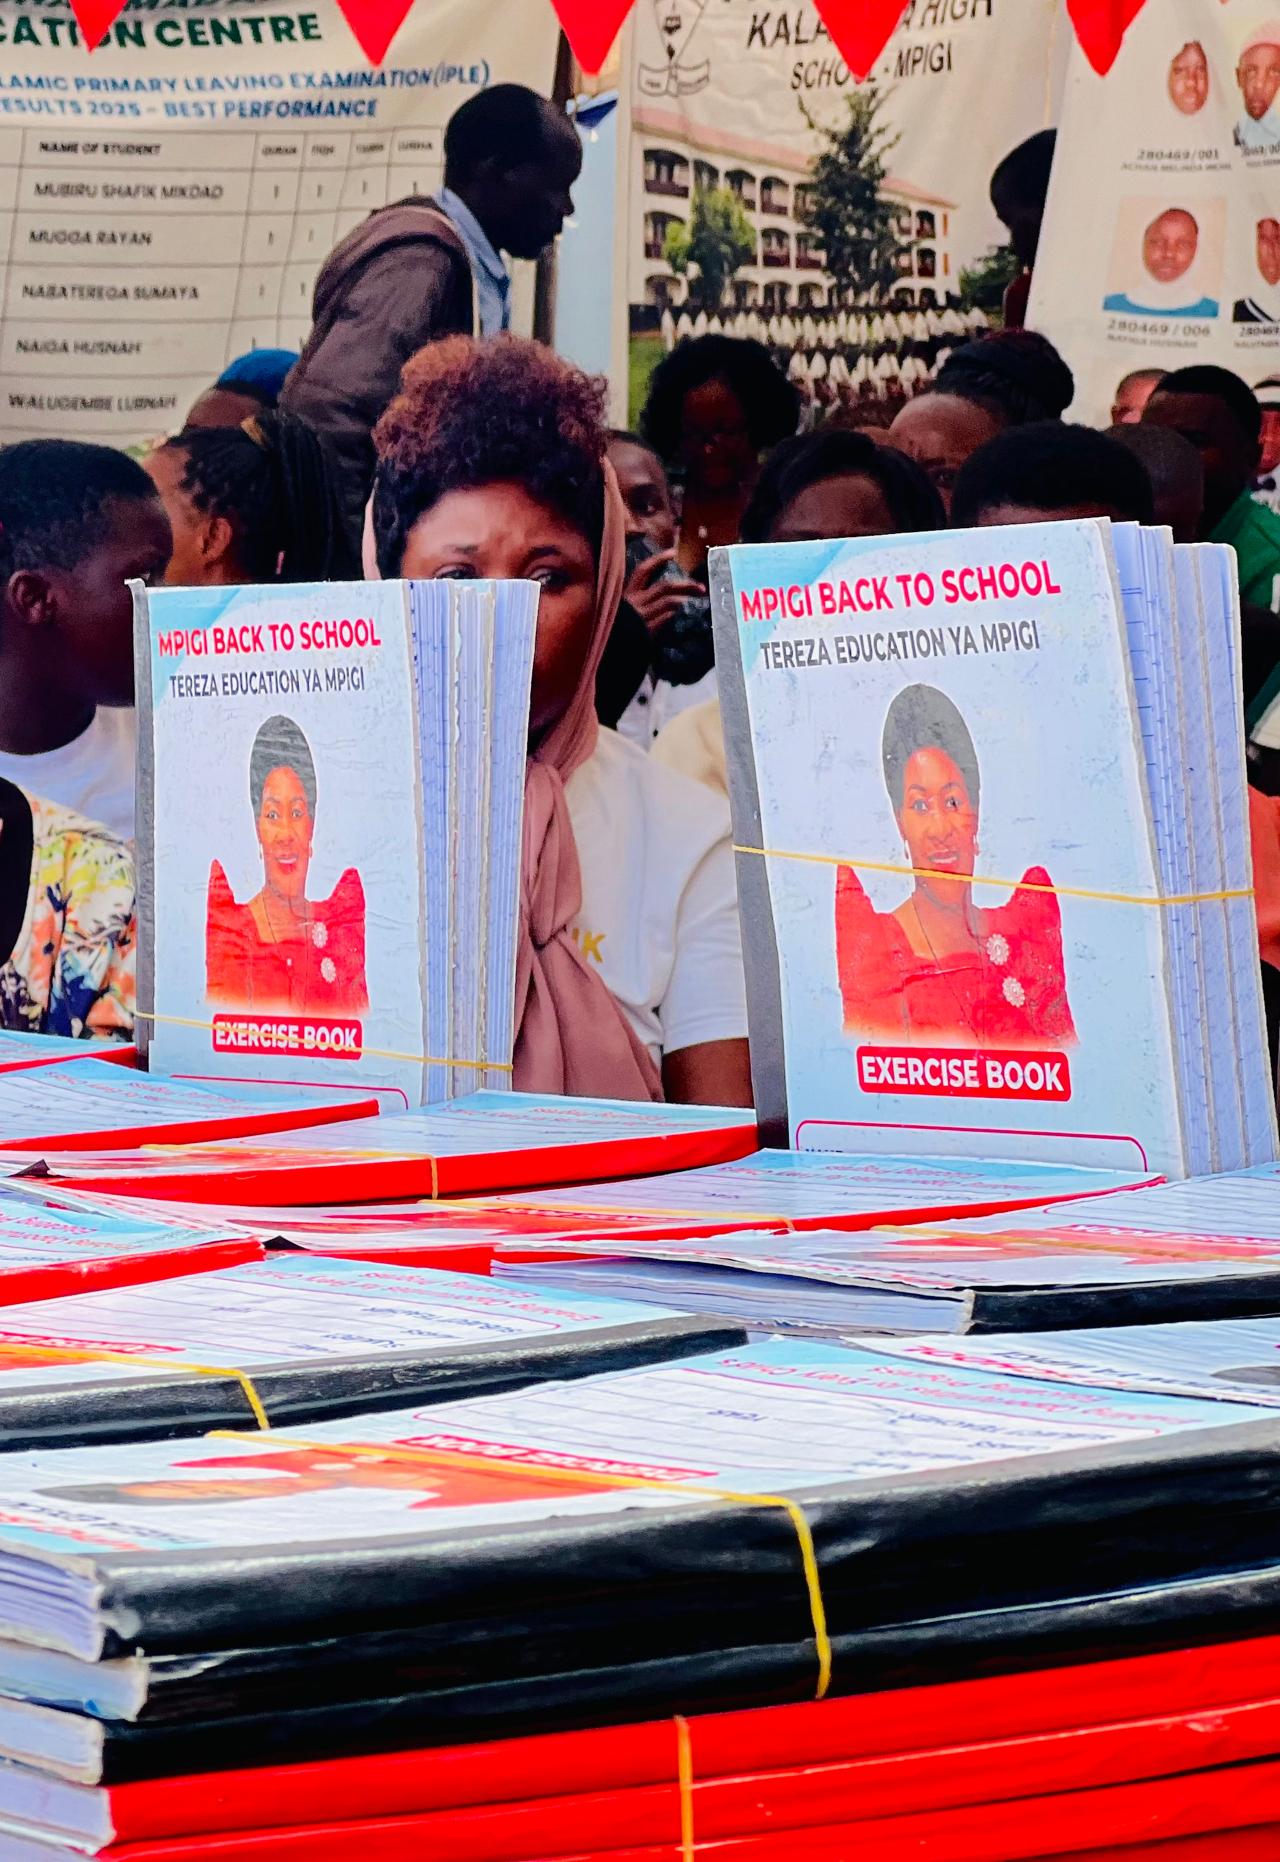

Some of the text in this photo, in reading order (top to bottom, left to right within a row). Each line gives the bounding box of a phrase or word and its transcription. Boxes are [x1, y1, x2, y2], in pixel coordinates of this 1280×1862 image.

[156, 14, 322, 47] CENTRE
[894, 42, 952, 79] MPIGI
[74, 76, 177, 92] PRIMARY
[185, 72, 284, 91] LEAVING
[165, 101, 218, 118] BEST
[224, 98, 378, 118] PERFORMANCE
[739, 559, 1062, 622] MPIGI BACK TO SCHOOL
[158, 617, 382, 658] MPIGI BACK TO SCHOOL
[759, 619, 1041, 671] TEREZA EDUCATION YA MPIGI
[169, 666, 366, 699] TEREZA EDUCATION YA MPIGI
[214, 1020, 359, 1053] EXERCISE BOOK
[860, 1053, 1065, 1093] EXERCISE BOOK
